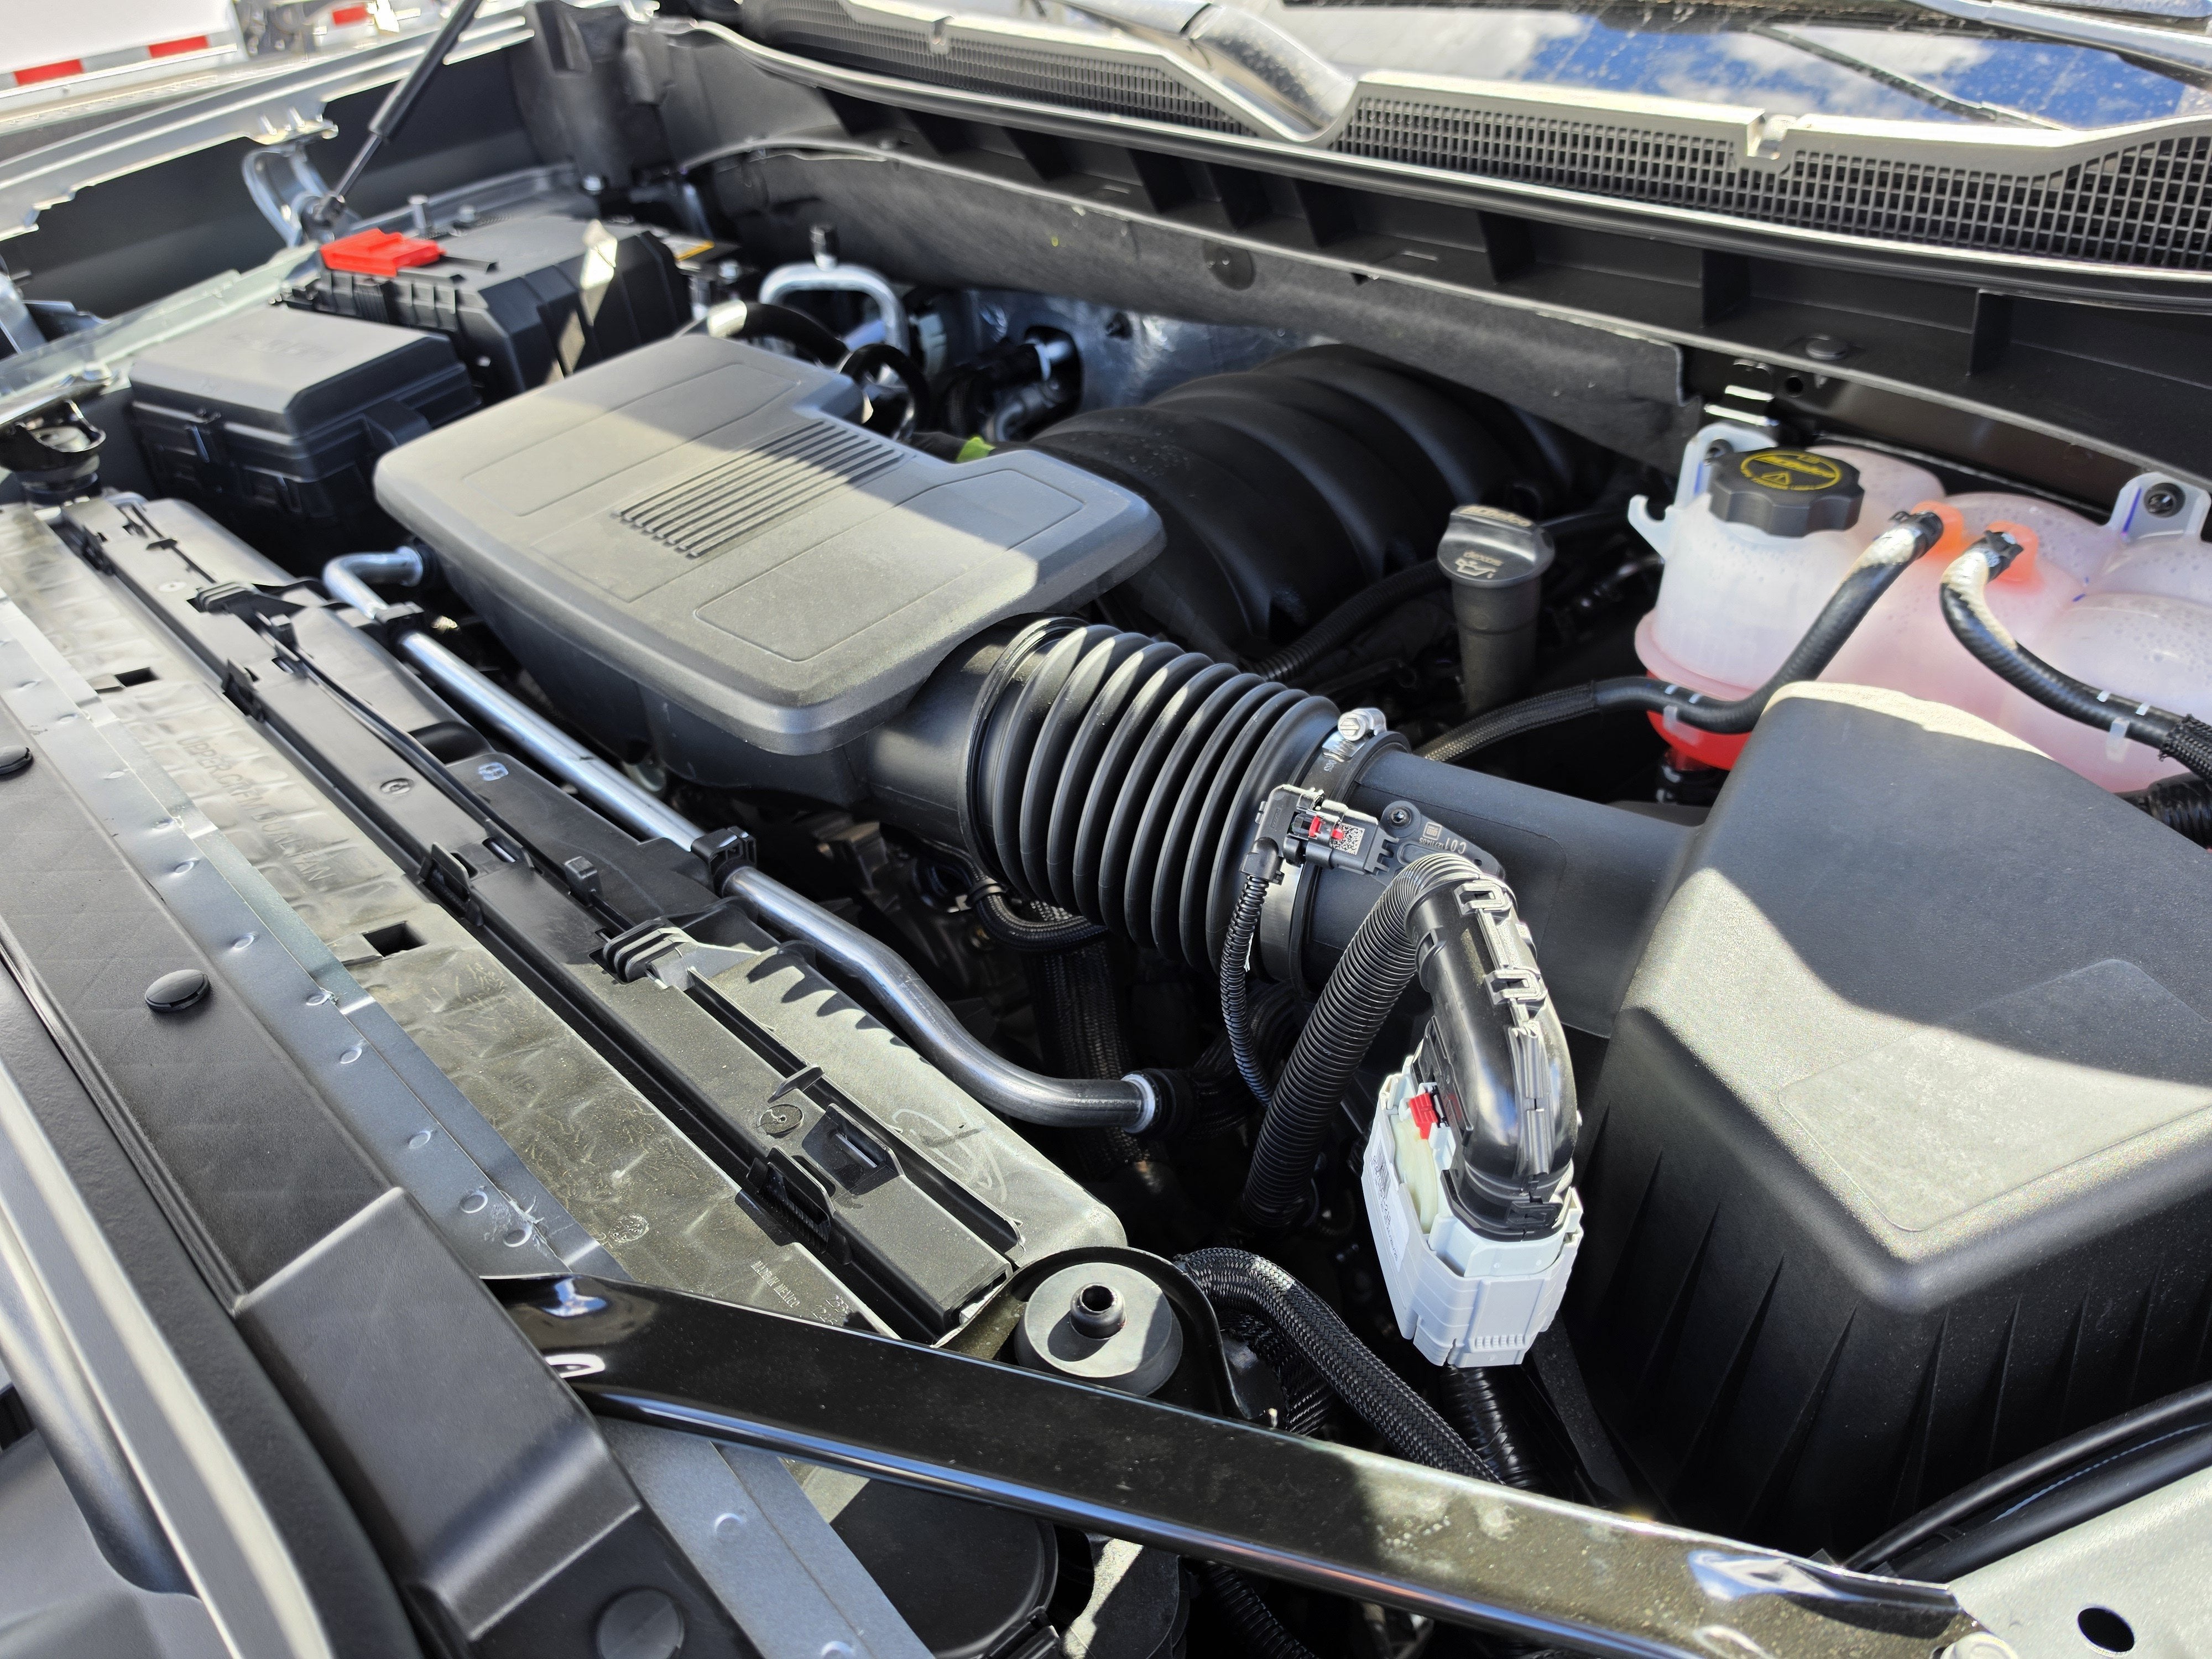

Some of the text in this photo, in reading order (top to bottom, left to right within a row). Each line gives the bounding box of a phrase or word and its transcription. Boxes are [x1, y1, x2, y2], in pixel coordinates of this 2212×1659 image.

[176, 735, 233, 775] UPPER
[251, 811, 303, 851] DUAL
[750, 1260, 800, 1308] MADE IN MEXICO
